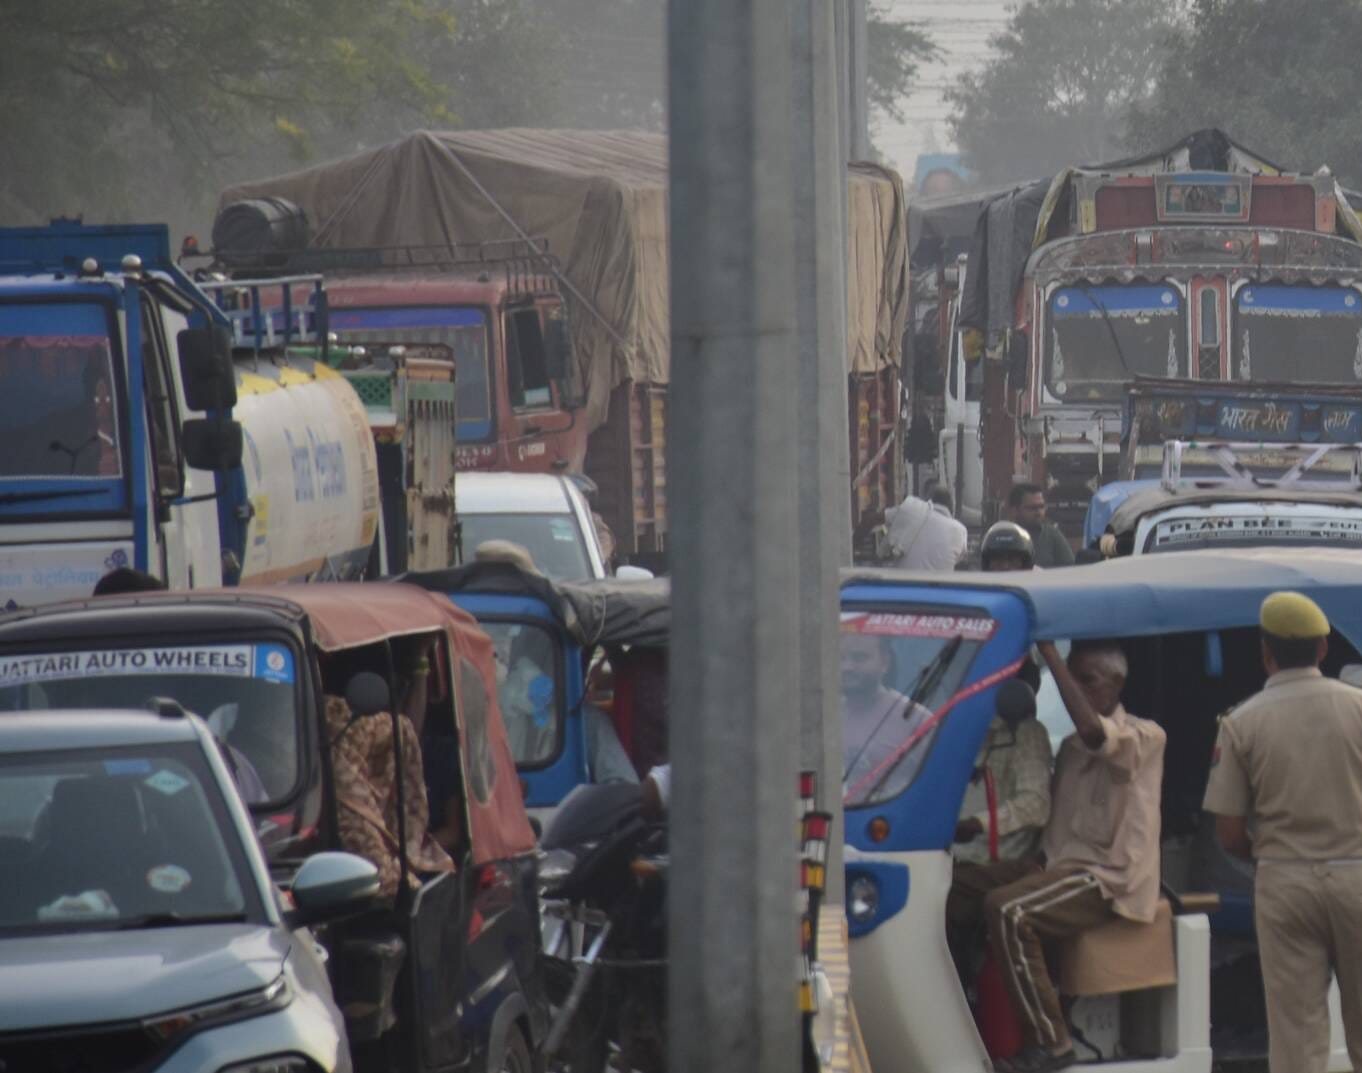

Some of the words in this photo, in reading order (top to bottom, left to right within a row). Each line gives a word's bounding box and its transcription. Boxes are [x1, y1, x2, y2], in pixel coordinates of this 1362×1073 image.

[1170, 519, 1234, 533] PLAN
[1244, 519, 1292, 528] BEE
[917, 615, 955, 629] AUTO
[956, 617, 994, 631] SALES
[86, 651, 147, 669] AUTO
[154, 651, 248, 669] WHEELS
